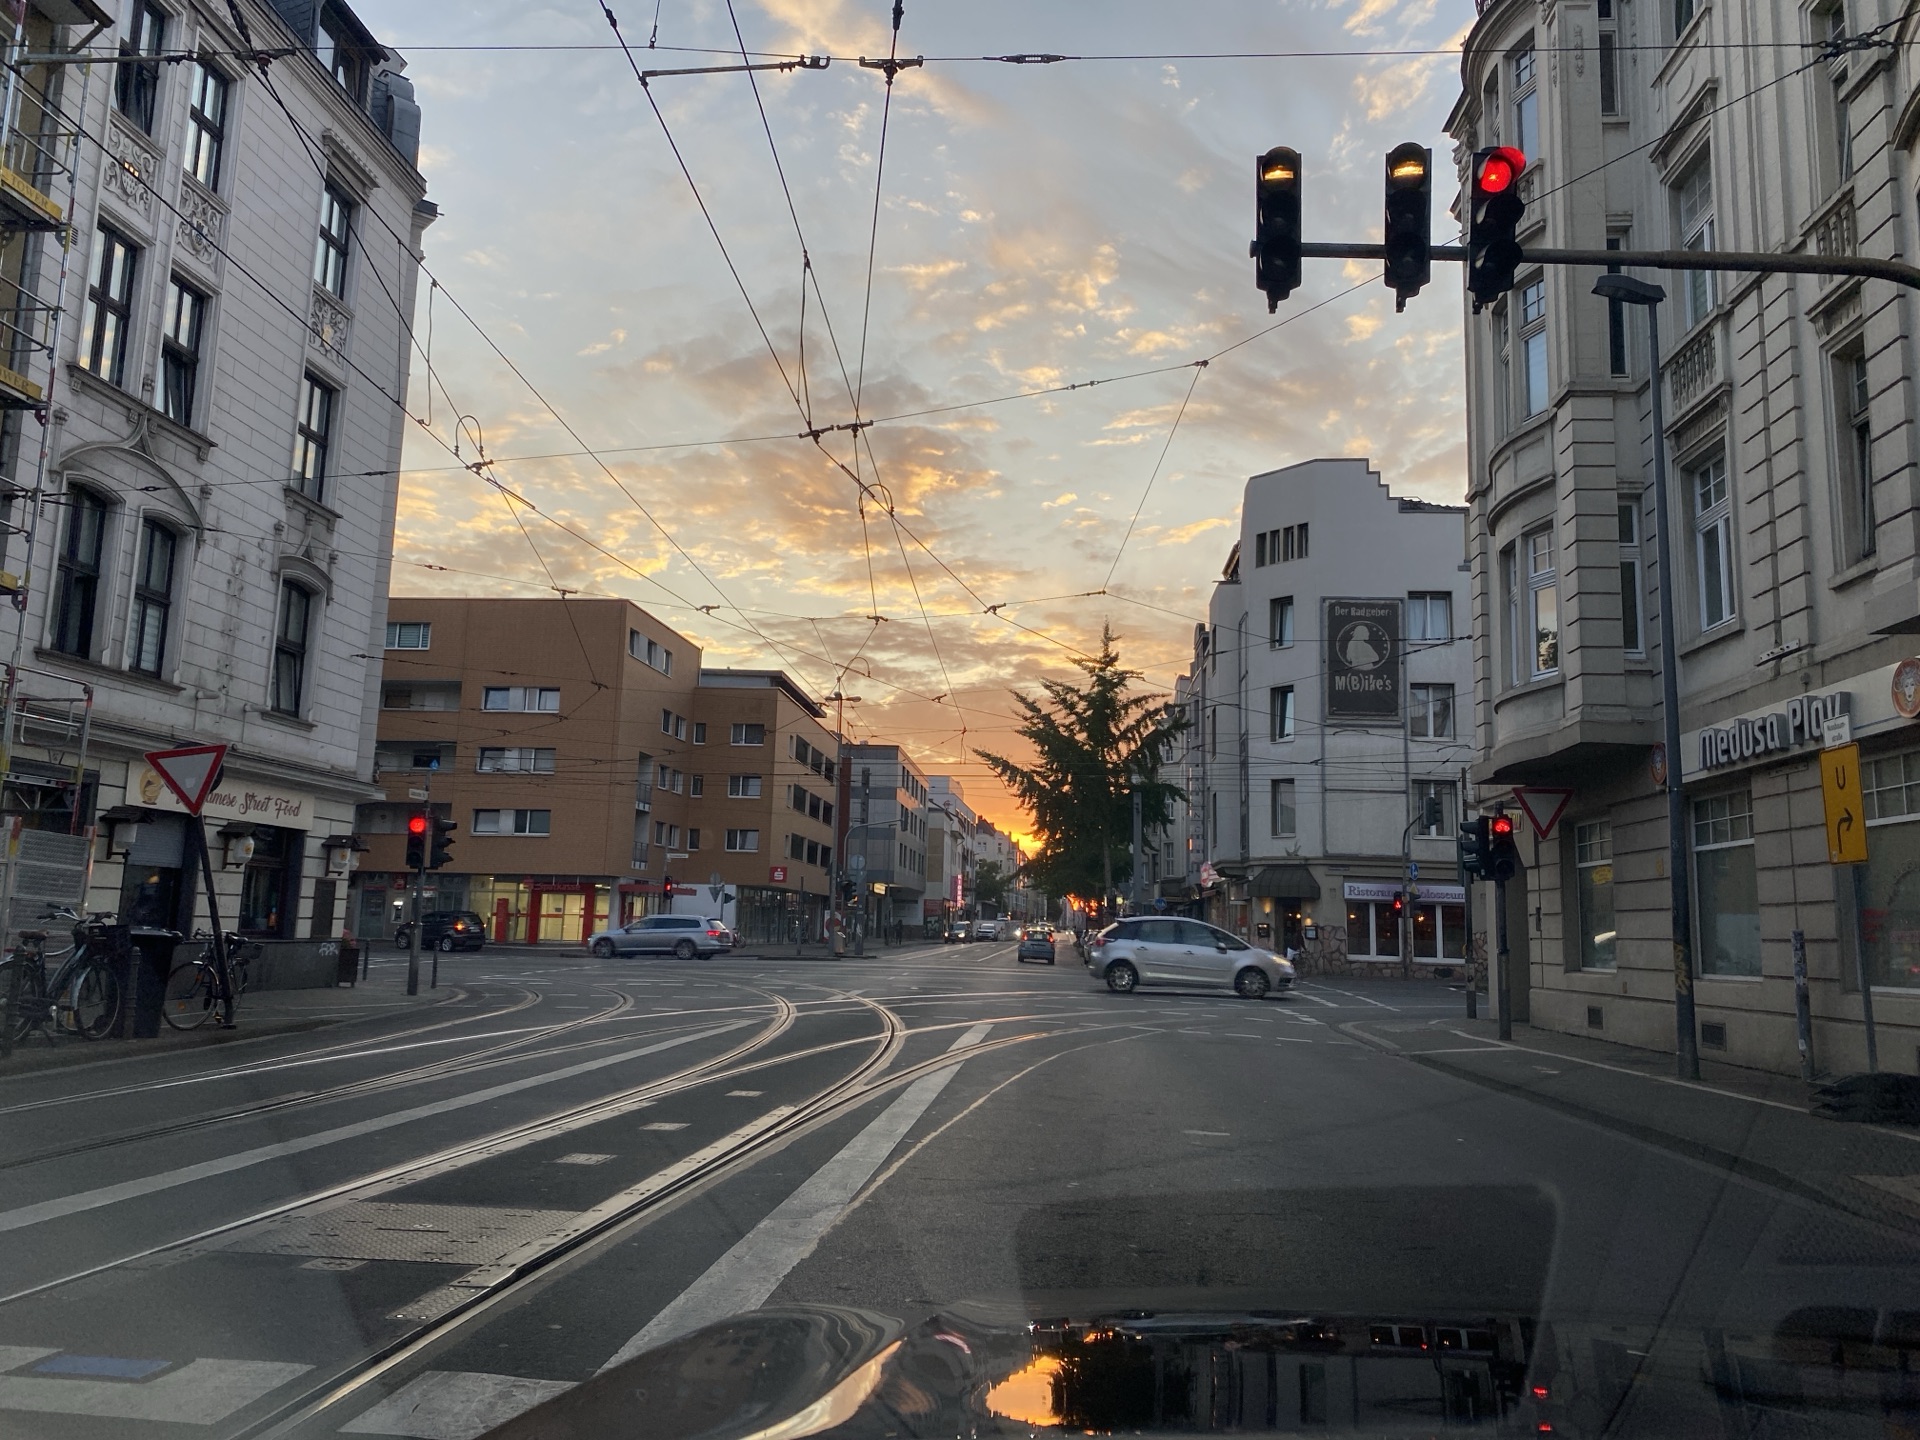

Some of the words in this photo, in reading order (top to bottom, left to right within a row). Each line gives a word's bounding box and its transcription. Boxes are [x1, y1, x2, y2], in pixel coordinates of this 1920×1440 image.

[0, 368, 29, 391] WER
[1335, 606, 1348, 616] Der
[1835, 765, 1846, 790] U
[239, 792, 273, 815] Street
[274, 797, 302, 819] Food
[1347, 885, 1394, 897] Ristoran
[1417, 888, 1465, 900] olosseum
